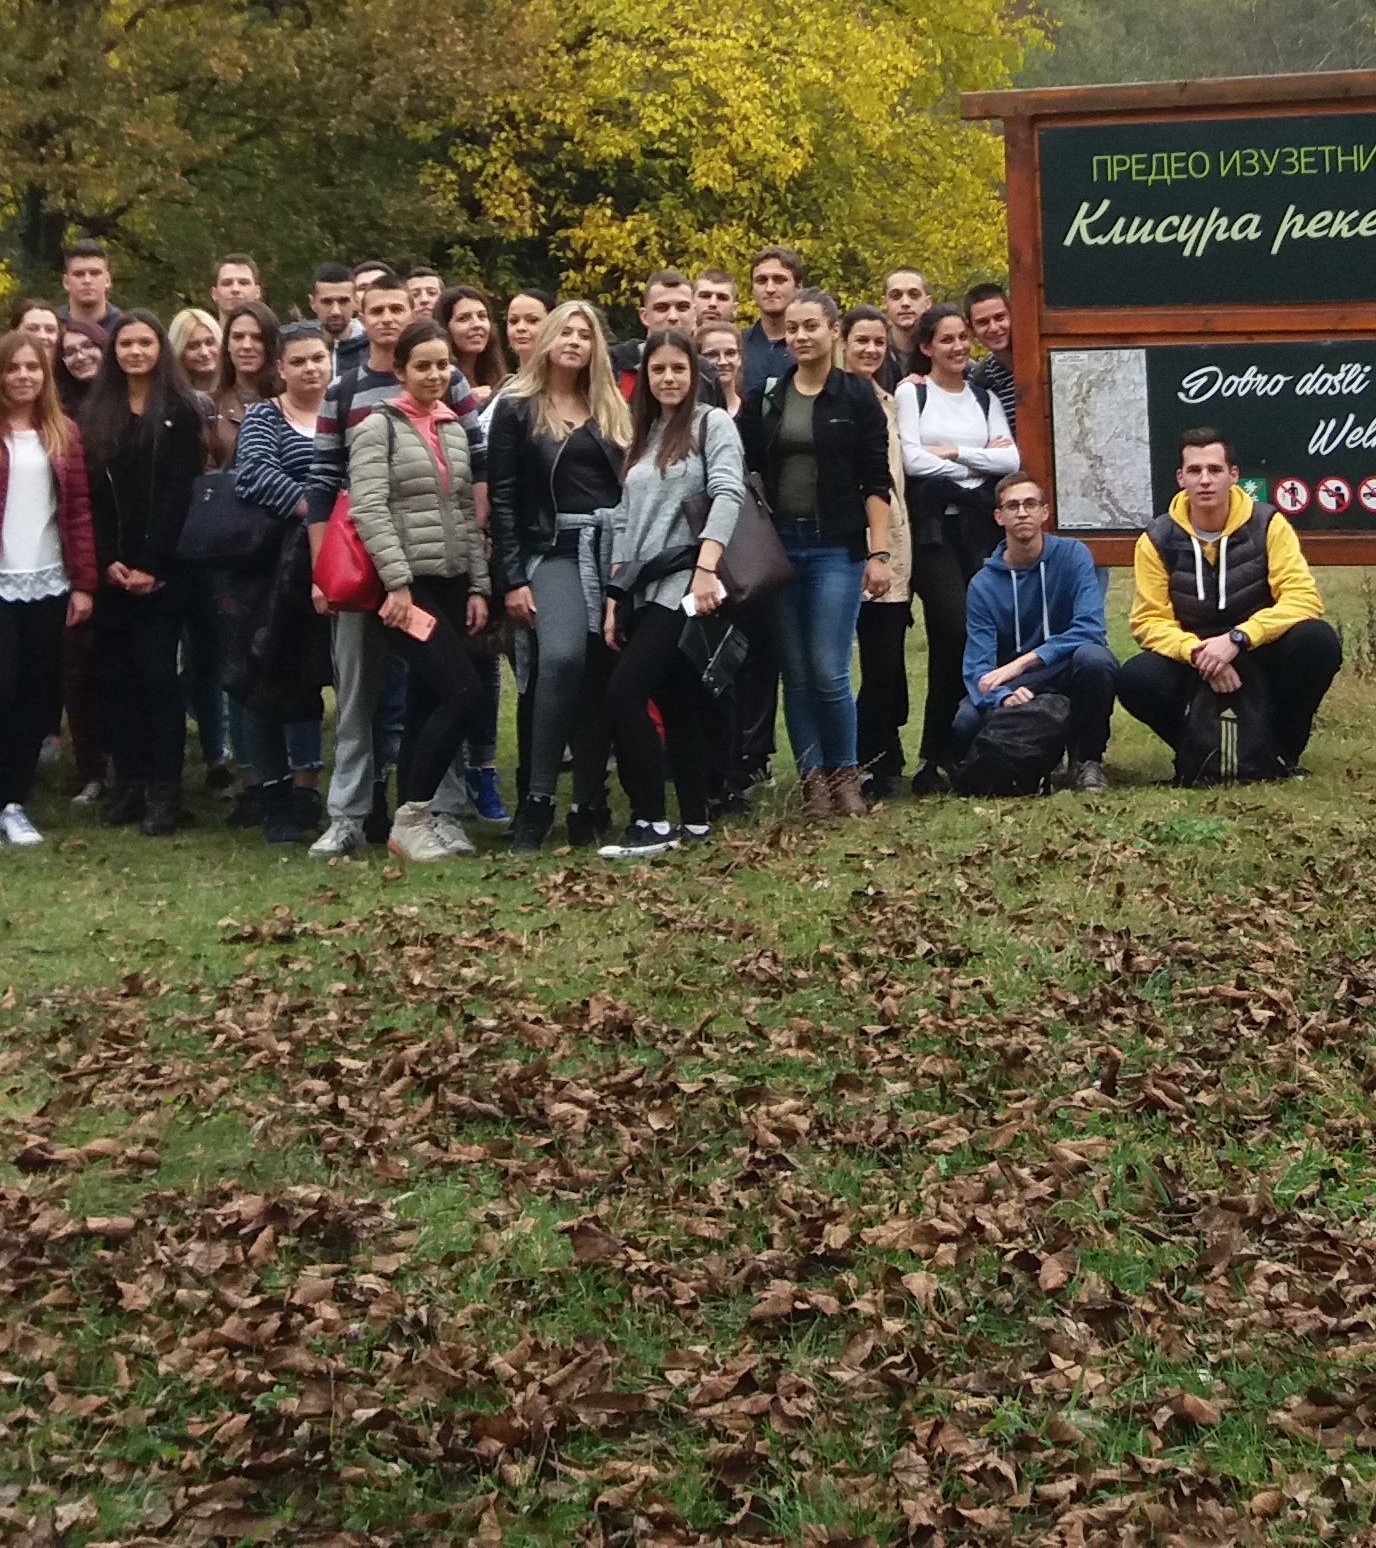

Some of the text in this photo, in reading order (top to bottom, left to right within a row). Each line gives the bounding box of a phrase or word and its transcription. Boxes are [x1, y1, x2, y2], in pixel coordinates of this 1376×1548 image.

[1092, 151, 1210, 186] ПРЕДЕО
[1062, 198, 1262, 257] Клисура
[1177, 362, 1372, 403] Dobro došli
